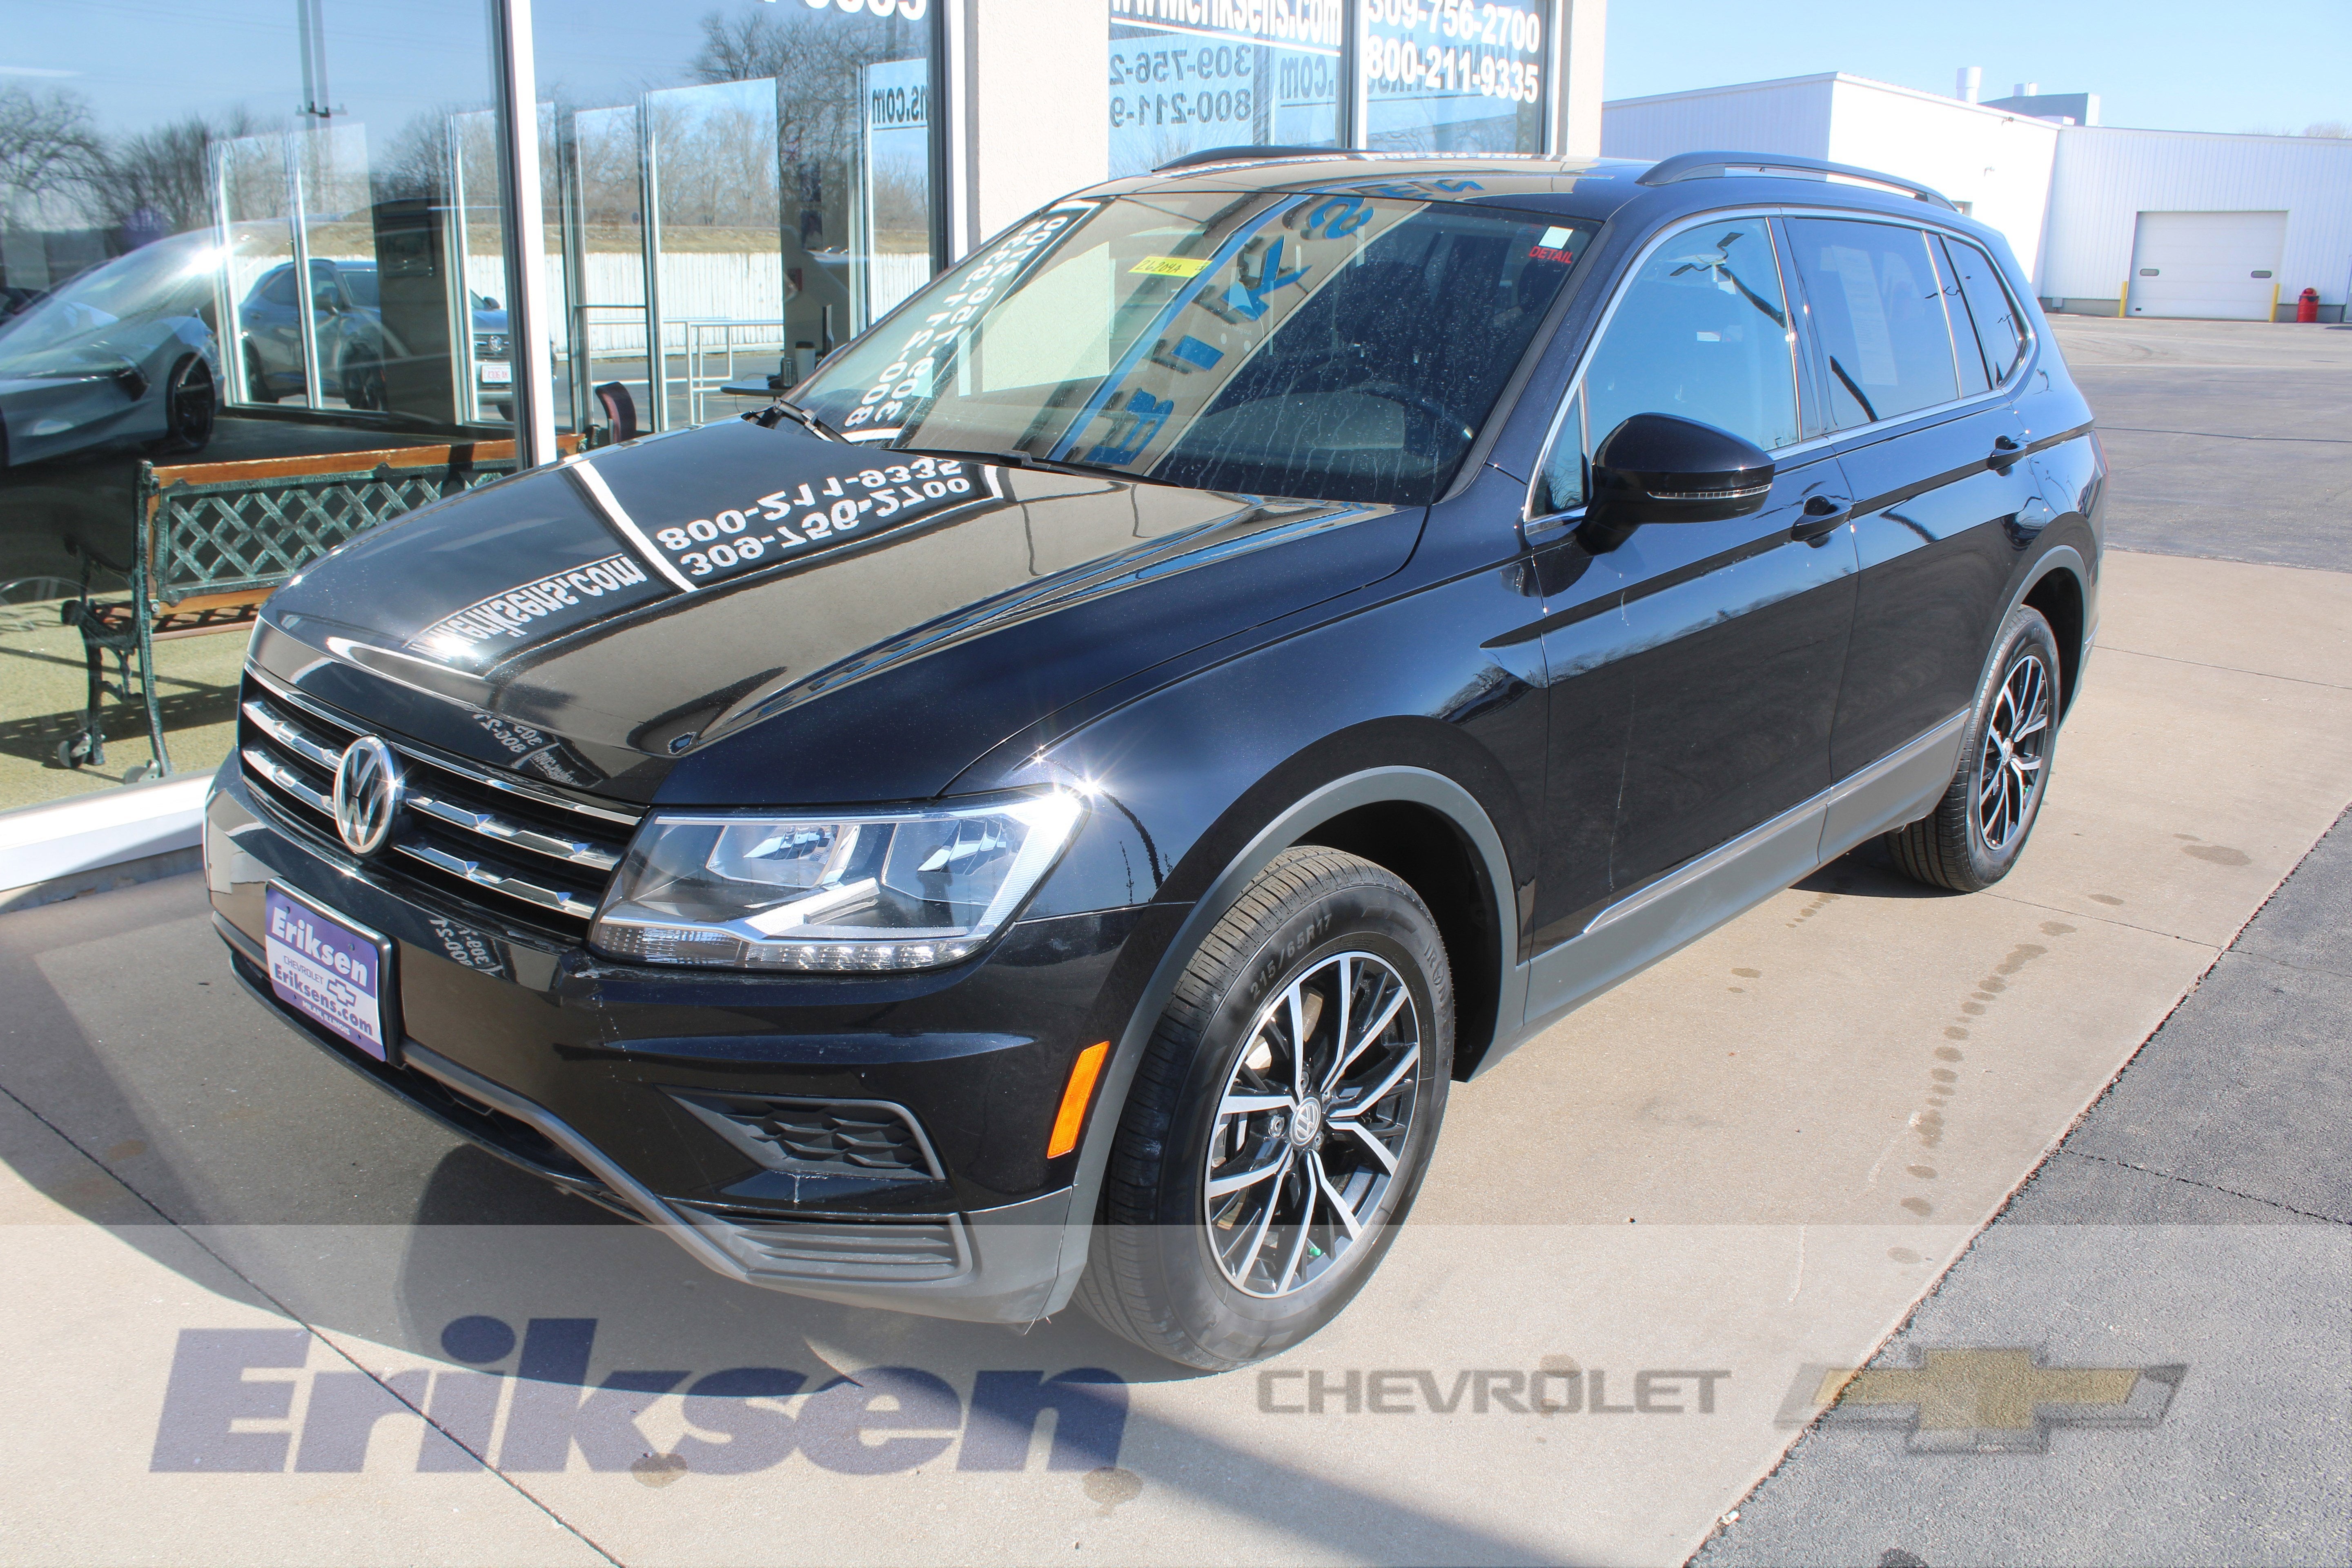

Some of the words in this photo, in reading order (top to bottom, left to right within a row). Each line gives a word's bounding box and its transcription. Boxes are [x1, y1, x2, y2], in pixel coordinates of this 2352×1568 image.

[1111, 0, 1342, 47] .ersens.com
[1368, 0, 1540, 53] 309-756-2700
[1366, 35, 1539, 104] 800-211-9335
[1528, 246, 1573, 264] DETAIL
[272, 906, 368, 987] Eriksen
[283, 955, 324, 985] CHEVROLET
[274, 962, 374, 1036] Eriksens.com
[302, 1000, 324, 1020] MILAN,
[323, 1013, 351, 1036] ILLINOIS
